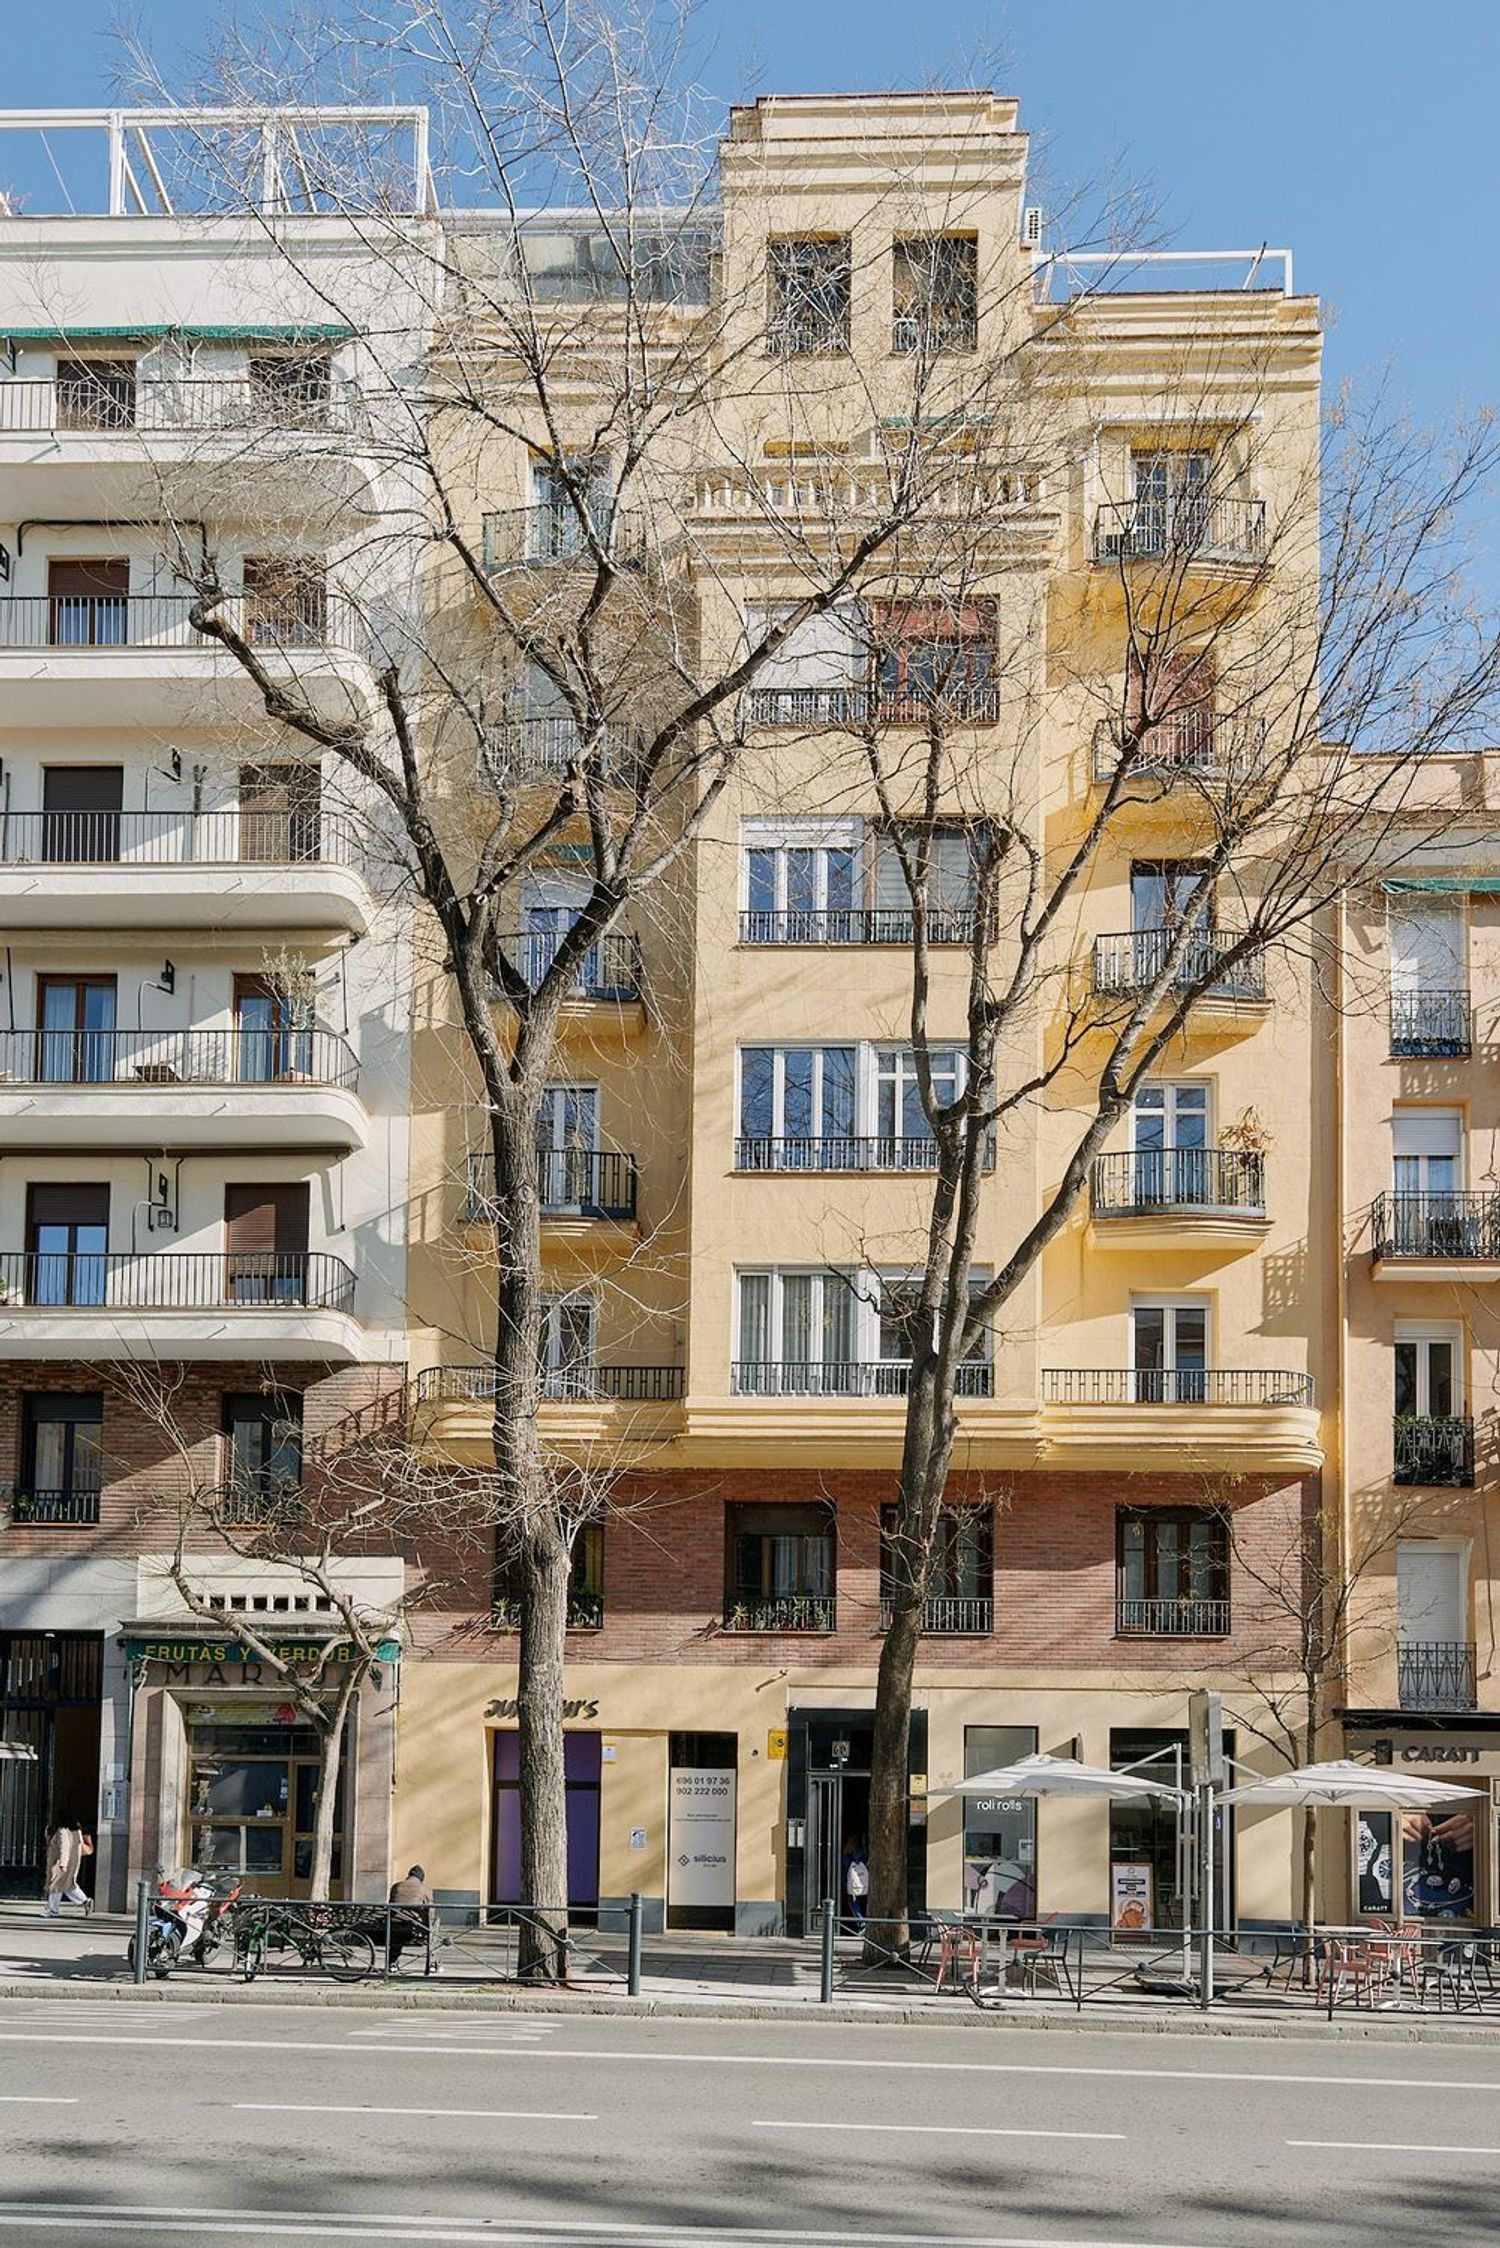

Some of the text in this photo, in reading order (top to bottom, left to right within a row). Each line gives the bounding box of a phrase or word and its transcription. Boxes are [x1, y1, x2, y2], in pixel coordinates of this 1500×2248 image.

[145, 1645, 226, 1661] FRUTAS
[240, 1645, 250, 1661] Y
[1401, 1746, 1482, 1763] CARATT
